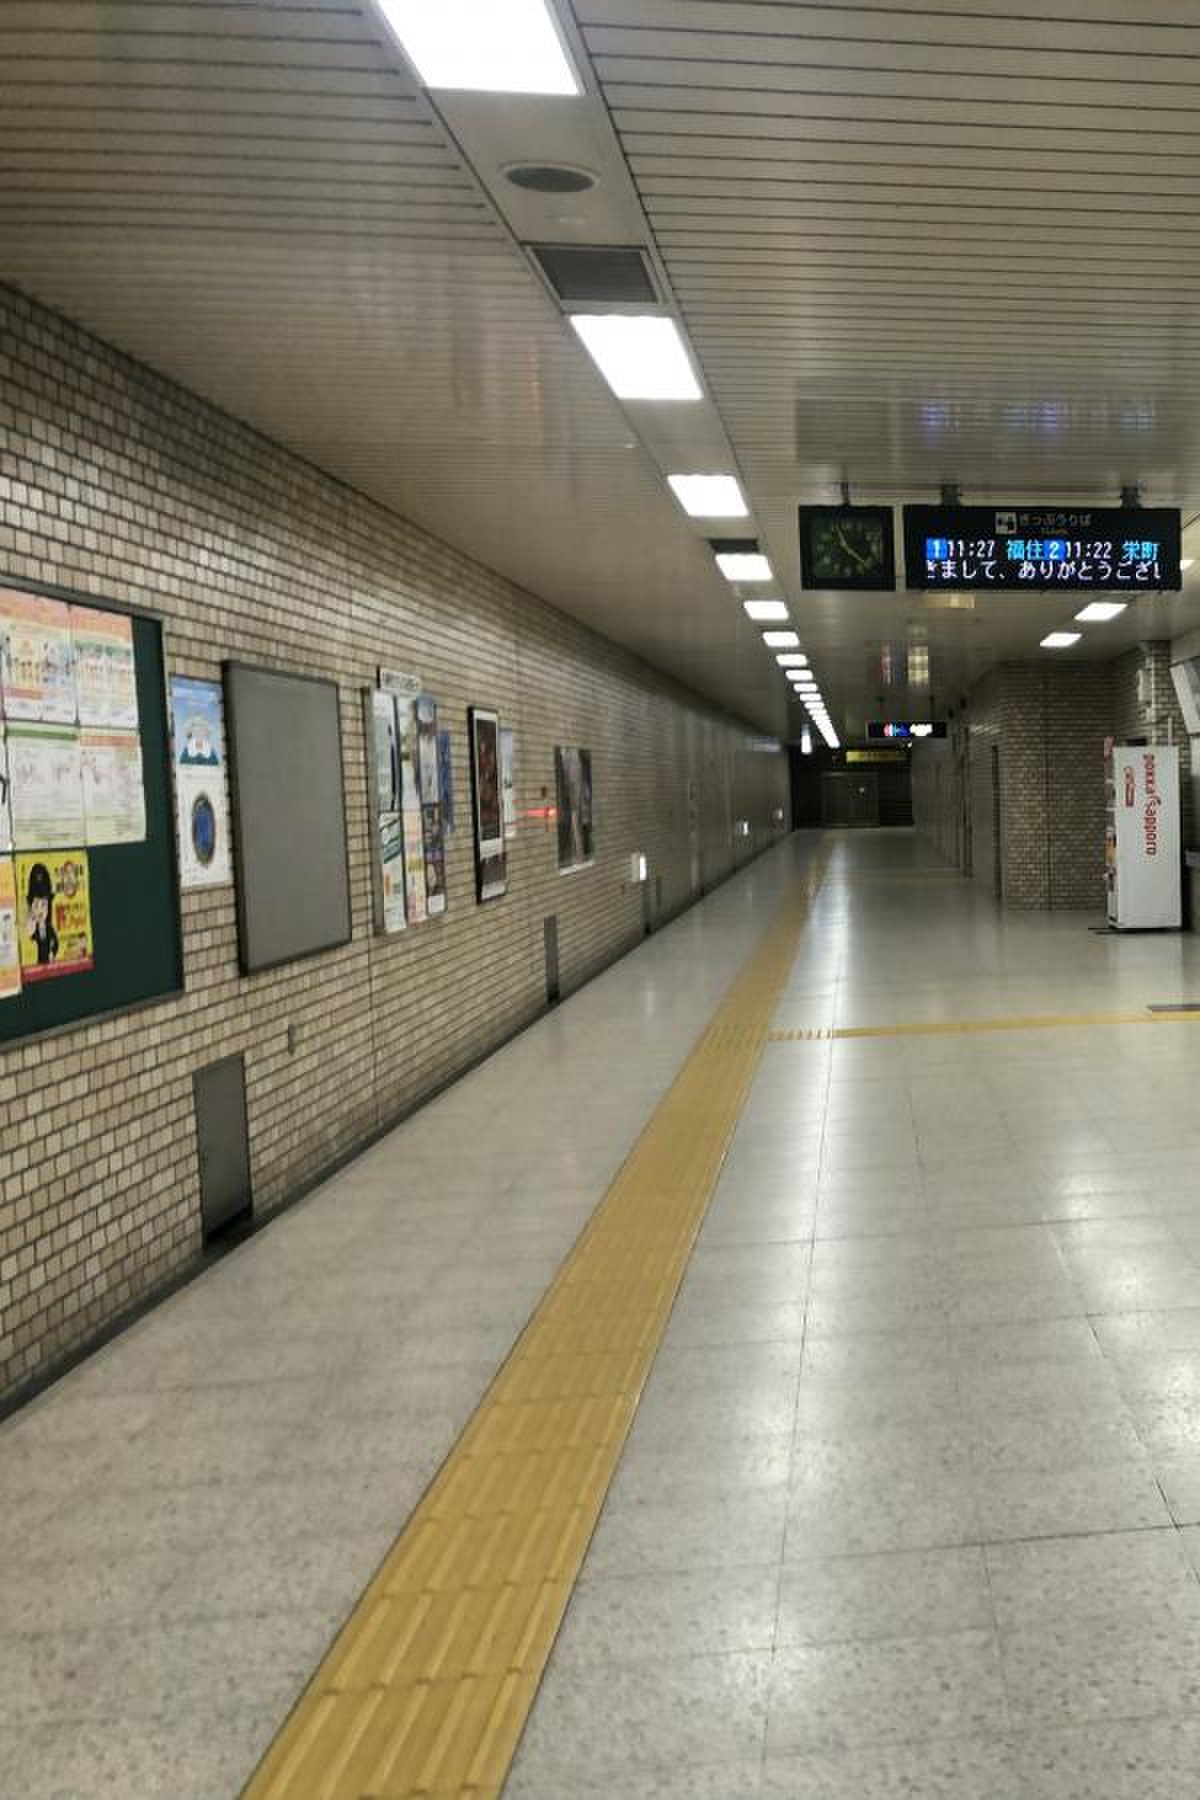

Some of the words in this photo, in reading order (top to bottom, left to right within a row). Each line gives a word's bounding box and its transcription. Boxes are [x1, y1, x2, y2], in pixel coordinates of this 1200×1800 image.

[948, 540, 995, 558] 11:27
[1007, 539, 1044, 560] 福住
[1066, 541, 1112, 559] 11:22
[1121, 540, 1160, 561] 栄町
